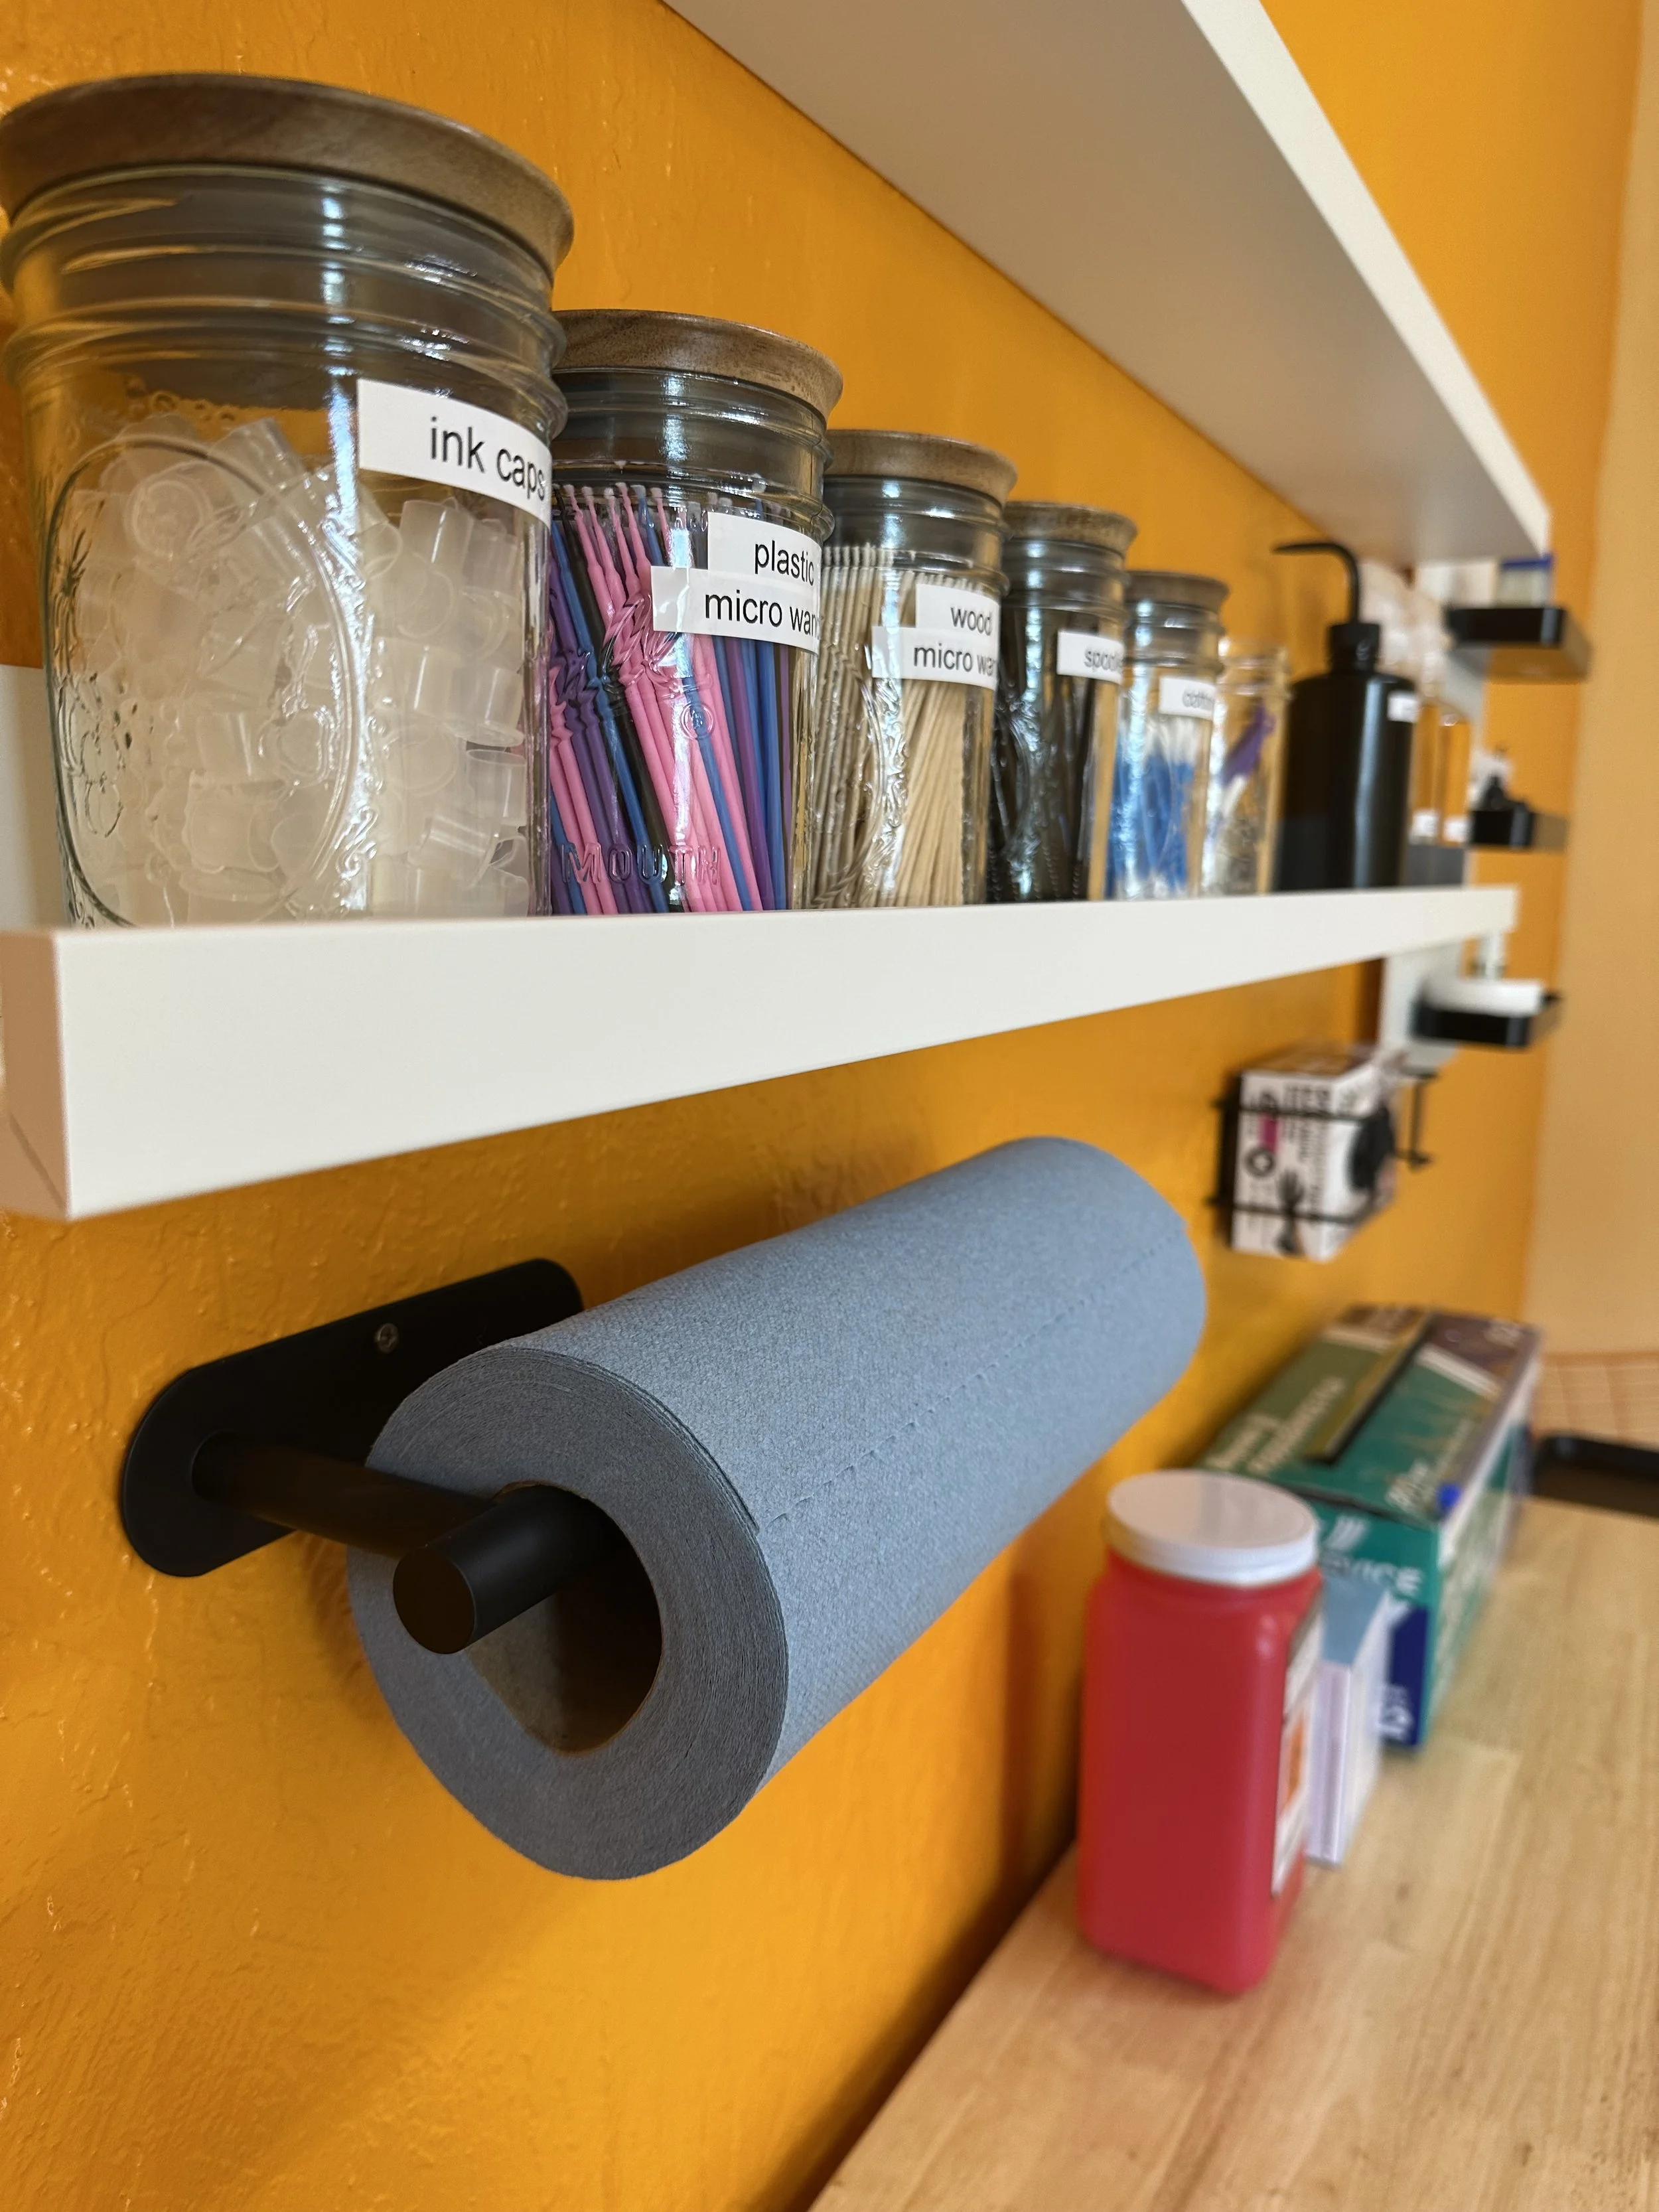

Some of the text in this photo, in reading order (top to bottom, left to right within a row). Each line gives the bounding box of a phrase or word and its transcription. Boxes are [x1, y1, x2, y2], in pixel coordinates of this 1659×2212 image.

[431, 417, 546, 501] ink caps
[755, 540, 815, 587] plastic
[705, 589, 783, 628] micro
[950, 607, 993, 636] wood
[913, 642, 974, 673] micro
